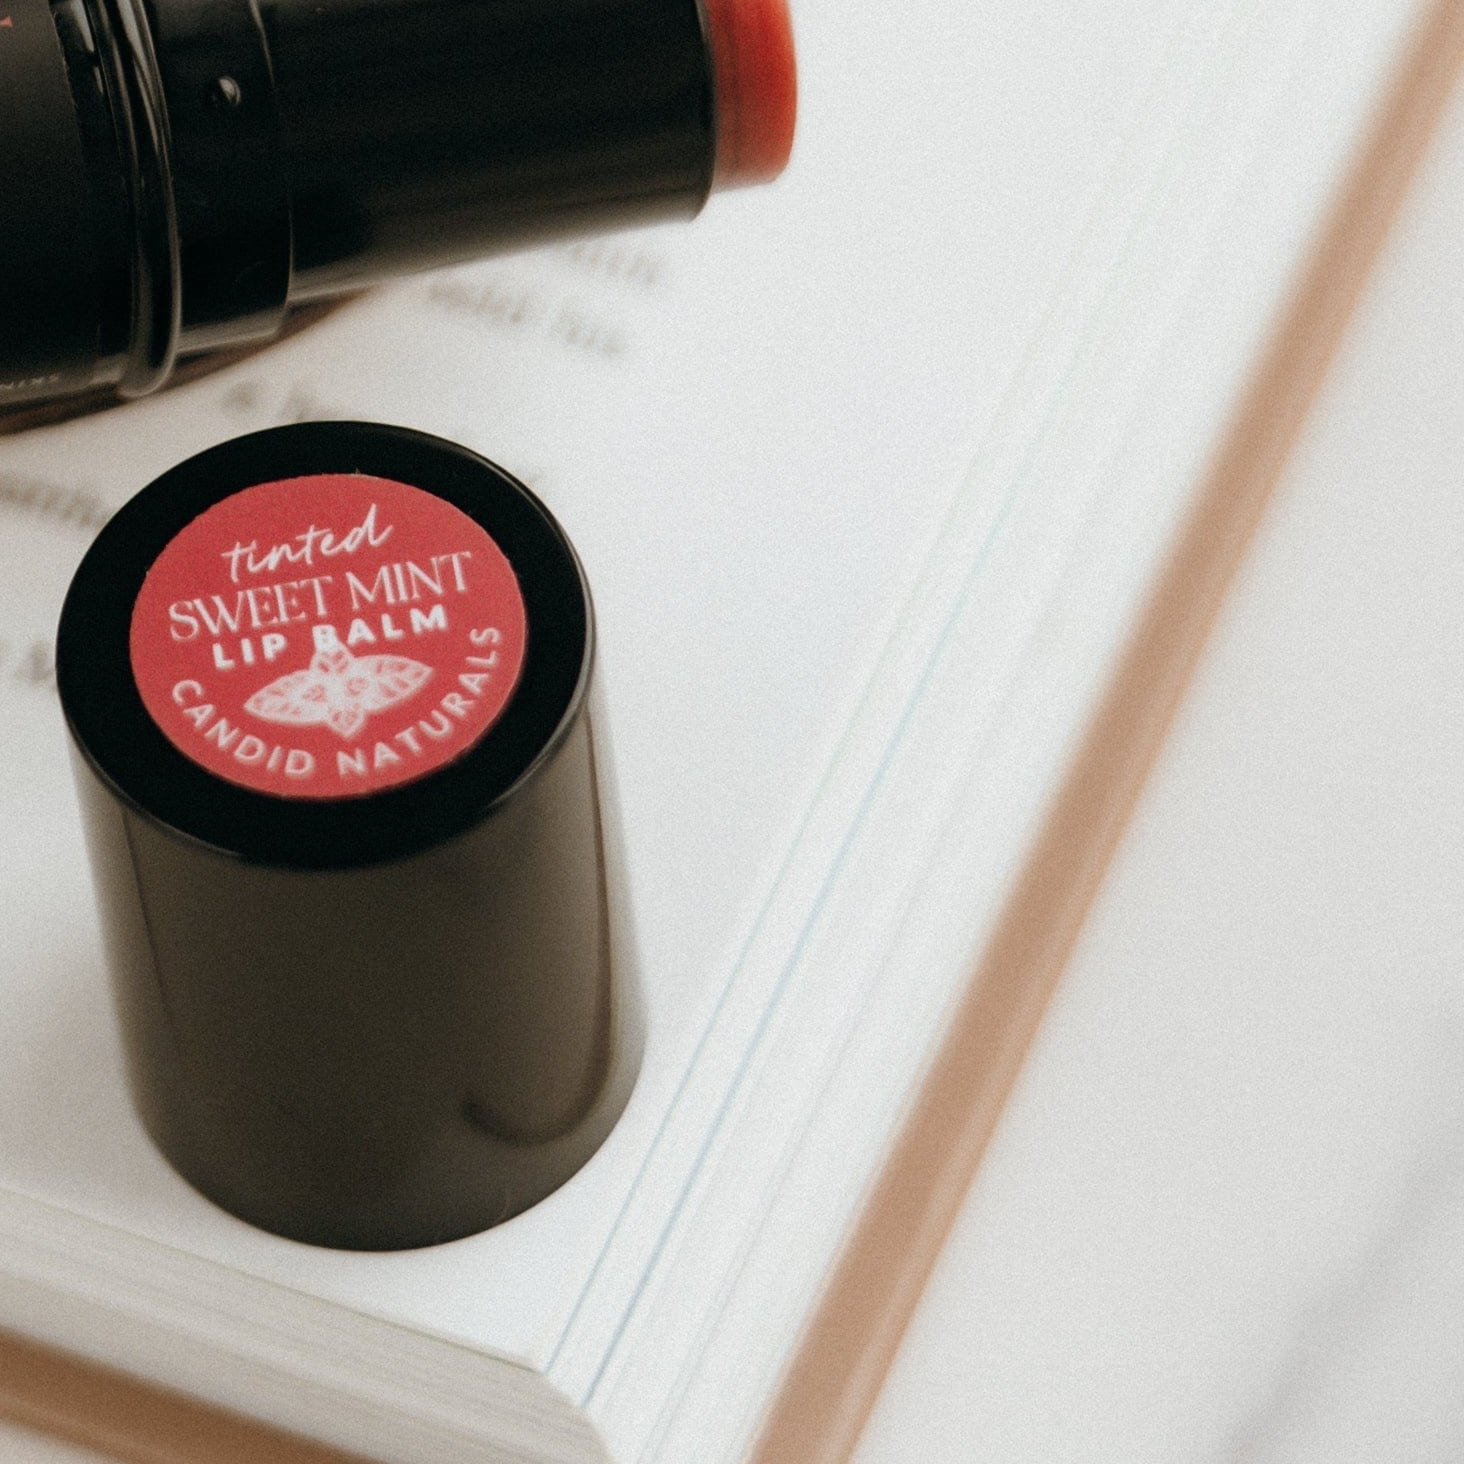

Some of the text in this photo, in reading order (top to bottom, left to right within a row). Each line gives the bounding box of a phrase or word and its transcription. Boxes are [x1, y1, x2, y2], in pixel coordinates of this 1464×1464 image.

[220, 503, 393, 583] tinted
[168, 551, 472, 641] SWEET MINT
[212, 604, 448, 669] LIP BALM
[172, 626, 501, 777] CANDID NATURALS
